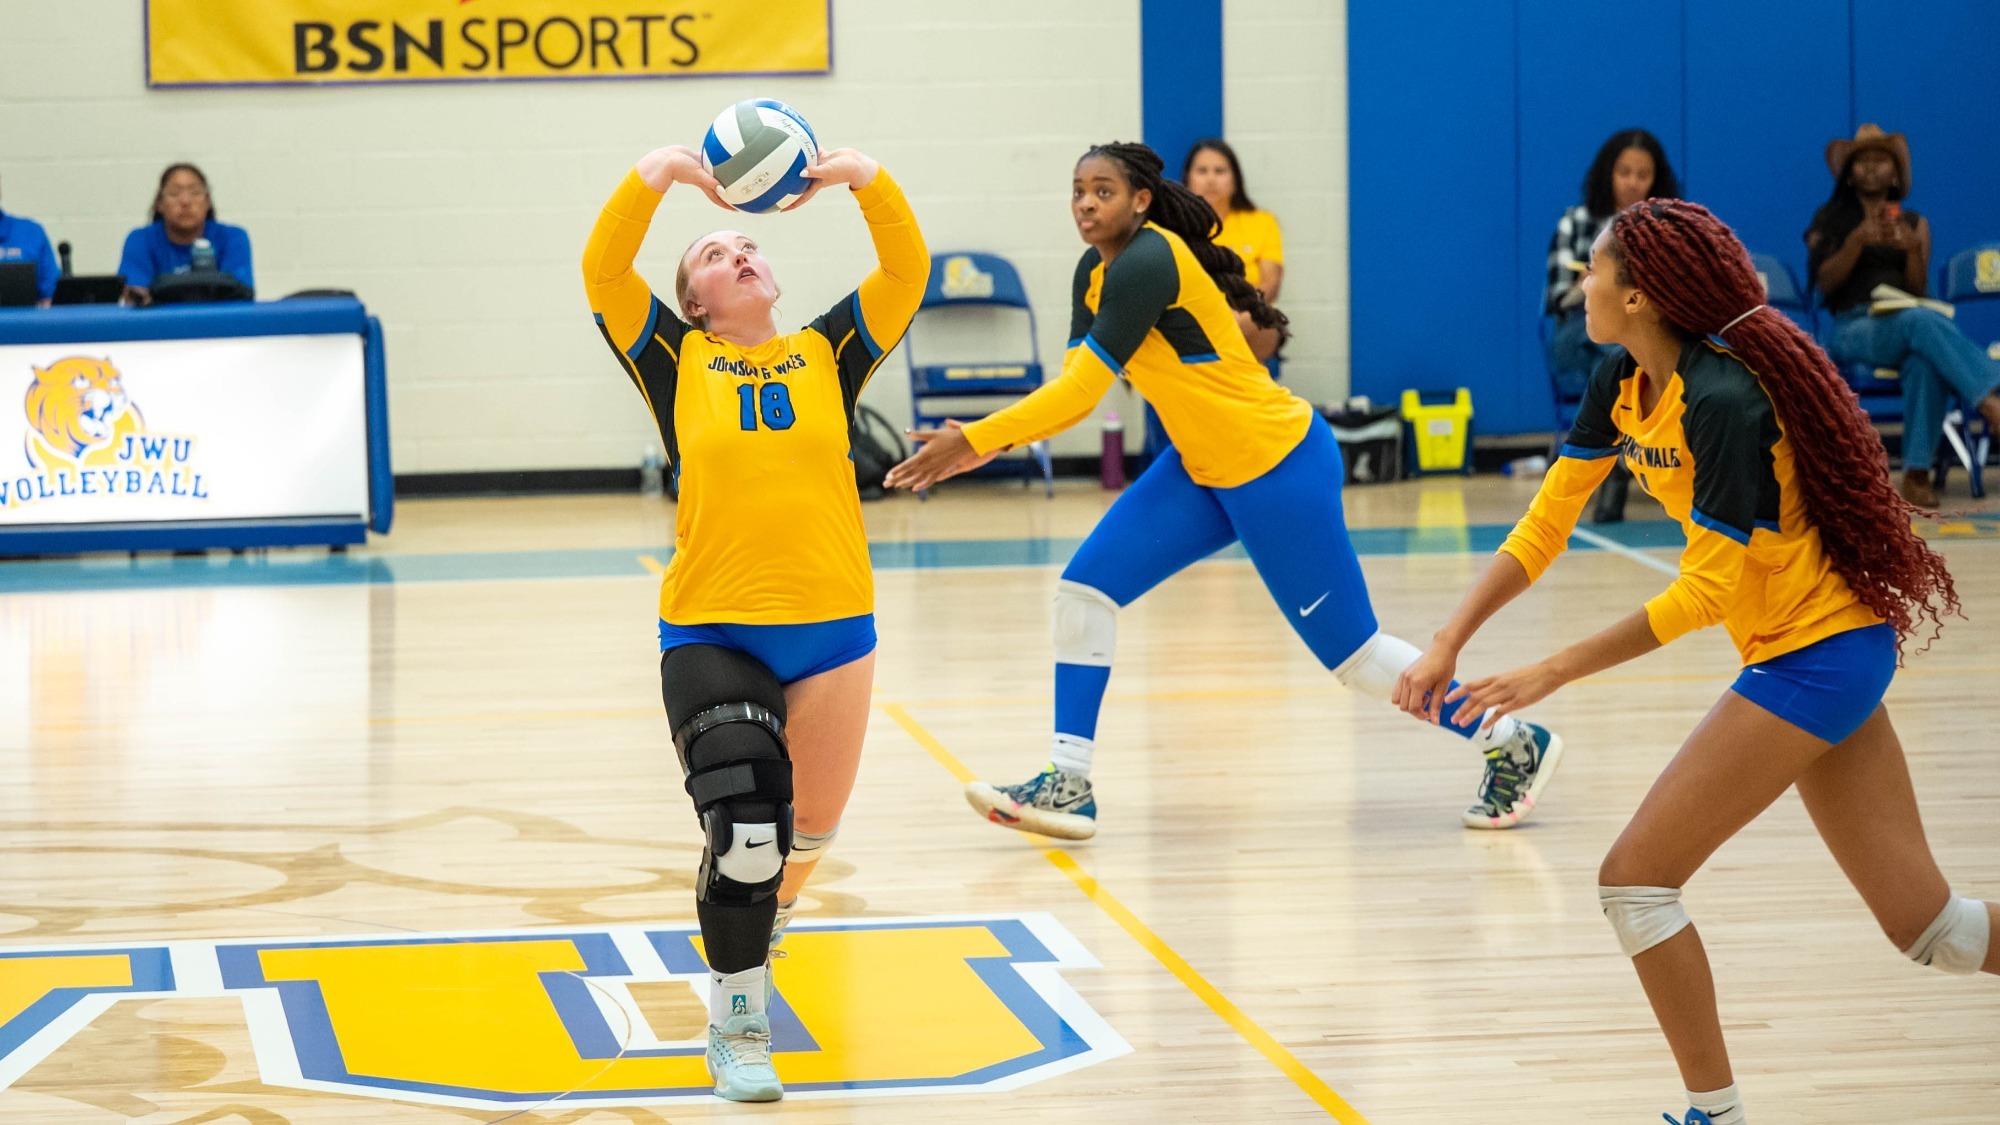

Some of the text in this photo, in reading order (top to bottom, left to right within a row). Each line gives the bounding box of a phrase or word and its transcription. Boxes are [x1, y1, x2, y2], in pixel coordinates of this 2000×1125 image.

[294, 14, 699, 74] BSN SPORTS
[761, 367, 772, 380] &
[736, 382, 796, 431] 18
[119, 436, 191, 462] JWU
